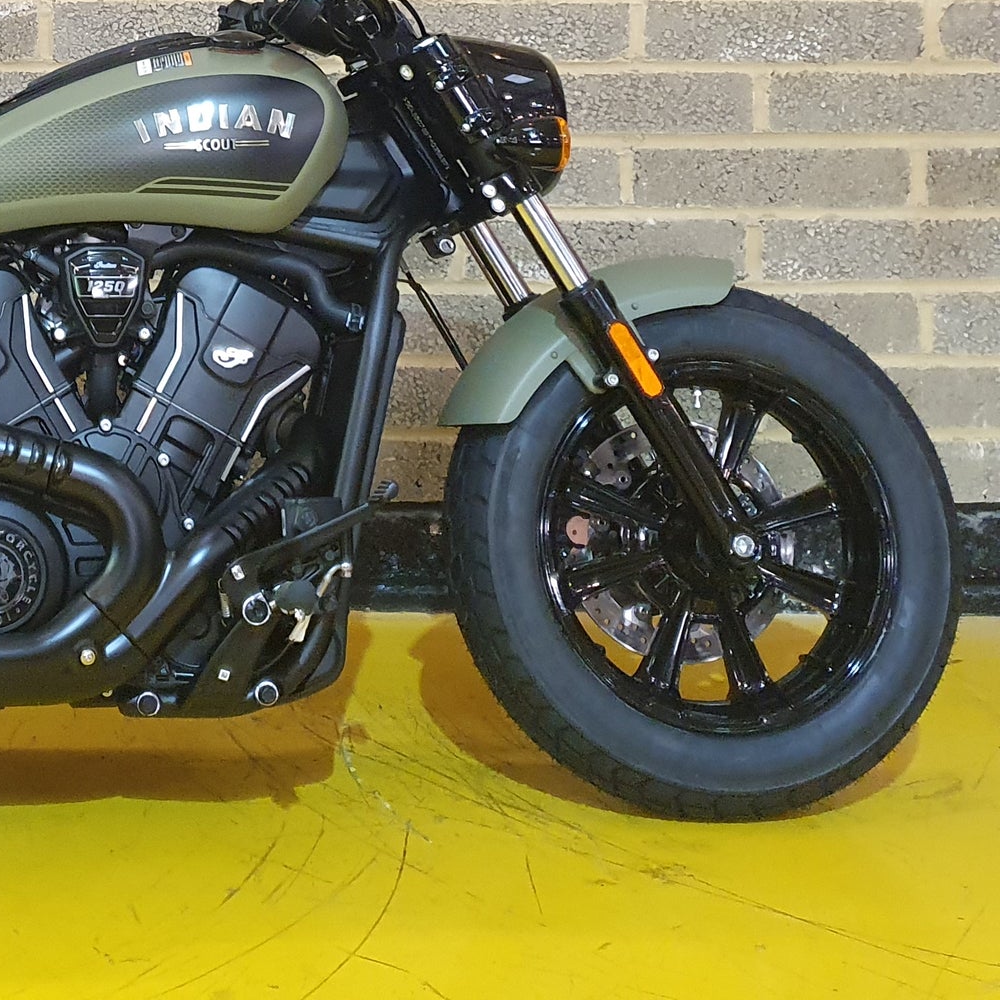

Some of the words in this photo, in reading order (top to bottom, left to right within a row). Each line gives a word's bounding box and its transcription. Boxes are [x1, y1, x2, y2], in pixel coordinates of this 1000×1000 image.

[133, 101, 296, 144] INDIAN
[195, 138, 237, 152] SCOUT
[87, 280, 126, 293] 1250
